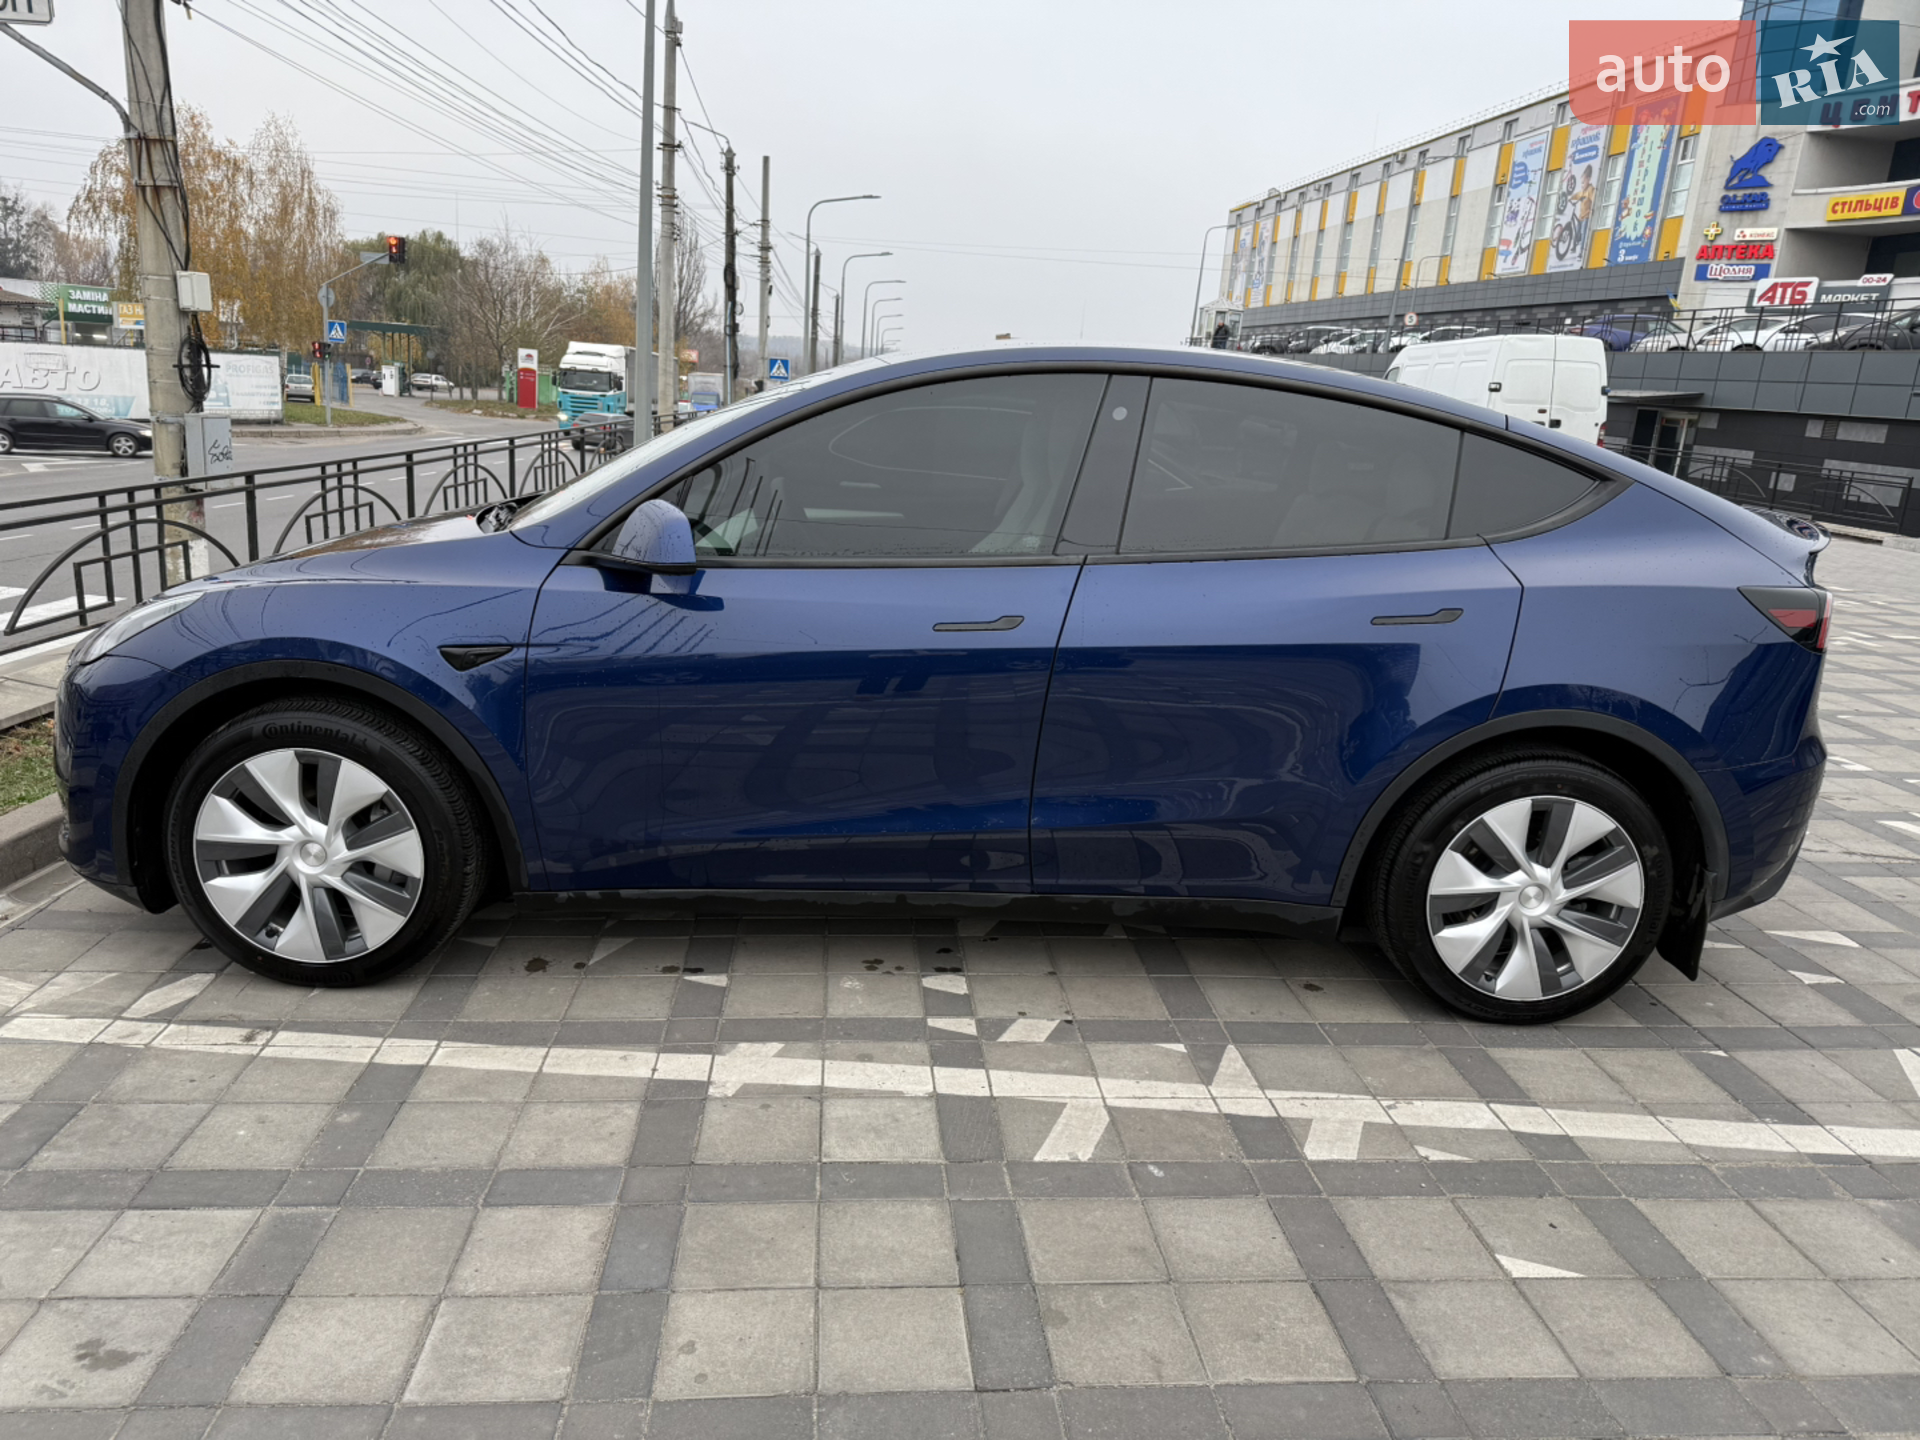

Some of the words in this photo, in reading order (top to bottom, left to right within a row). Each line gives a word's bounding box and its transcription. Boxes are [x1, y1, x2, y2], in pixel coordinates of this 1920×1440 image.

[1830, 196, 1900, 215] СТІЛЬЦІВ
[1695, 244, 1774, 260] АПТЕКА
[68, 289, 109, 302] ЗАМІНА
[1756, 281, 1814, 305] АТБ
[1820, 293, 1880, 305] МАРКЕТ
[225, 363, 275, 374] PROFIGAS
[262, 720, 358, 742] Continental
